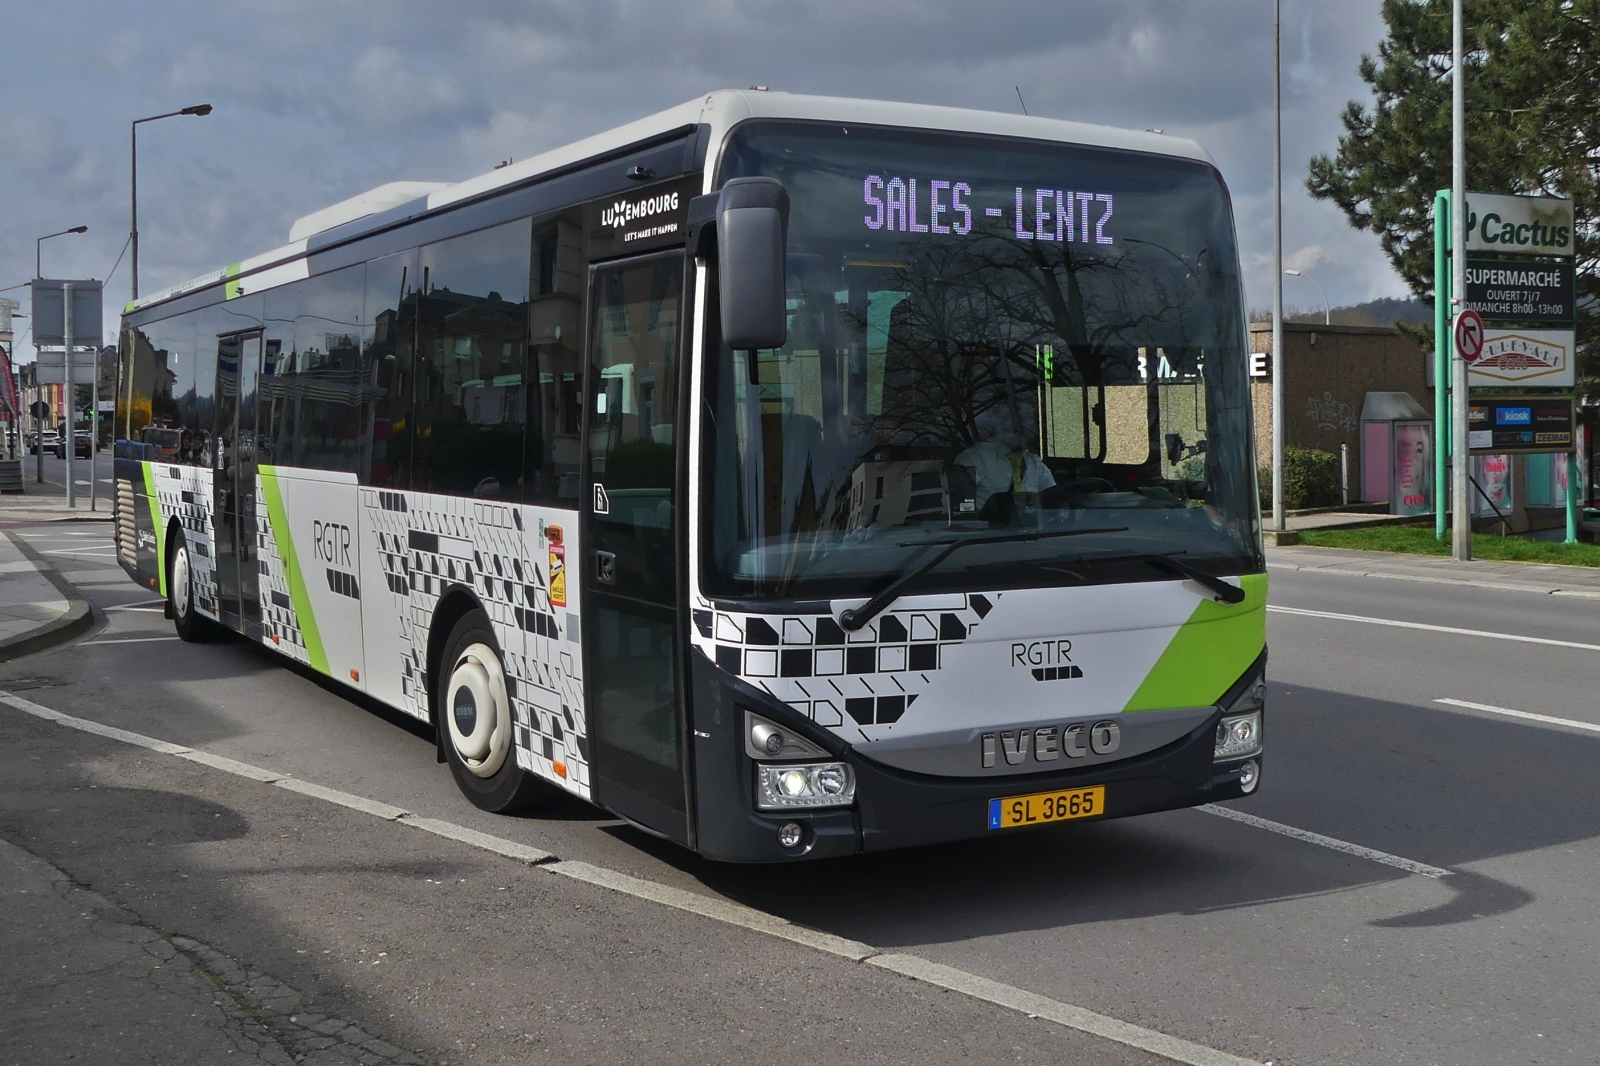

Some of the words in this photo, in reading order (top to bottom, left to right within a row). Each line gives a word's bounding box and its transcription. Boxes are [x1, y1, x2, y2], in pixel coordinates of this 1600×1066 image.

[602, 192, 679, 229] LUXEMBOURG
[864, 174, 971, 235] SALES
[1015, 186, 1113, 245] LENTZ
[624, 231, 637, 242] LET'S
[637, 228, 651, 239] MAKE
[651, 226, 658, 236] IT
[657, 223, 678, 235] HAPPEN
[1481, 213, 1570, 248] Cactus
[1465, 268, 1561, 287] SUPERMARCHÉ
[1466, 301, 1510, 313] DIMANCHE
[1486, 289, 1521, 301] OUVERT
[1536, 433, 1569, 442] ZEEMAN
[314, 519, 351, 568] RGTR
[1011, 639, 1072, 667] RGTR
[981, 719, 1121, 769] IVECO
[1011, 800, 1037, 823] SL
[1042, 791, 1094, 820] 3665
